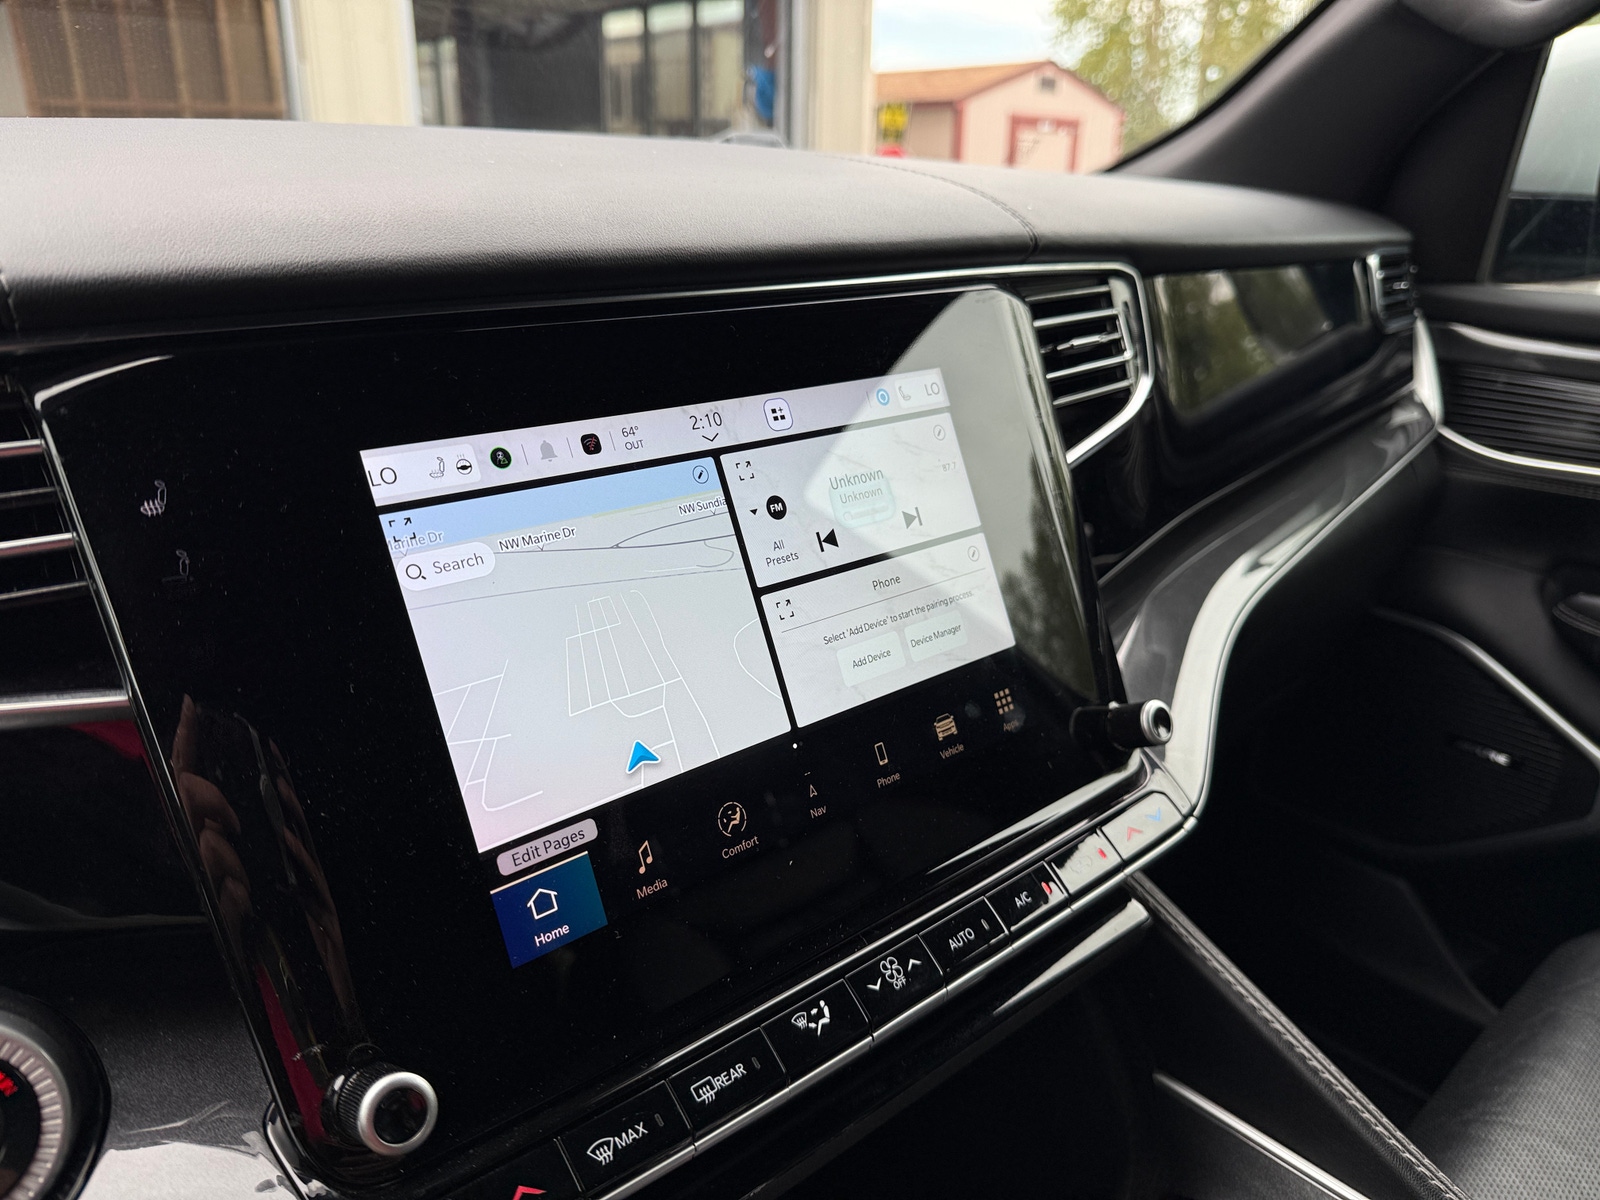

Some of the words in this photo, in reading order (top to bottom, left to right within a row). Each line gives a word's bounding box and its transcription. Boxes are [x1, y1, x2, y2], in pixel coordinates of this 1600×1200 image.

[925, 382, 939, 396] LO
[690, 411, 723, 431] 2:10
[621, 425, 639, 439] 64°
[625, 440, 644, 450] OUT
[942, 462, 957, 473] 87.7
[368, 466, 398, 487] LO
[829, 469, 884, 490] Unknown
[840, 487, 883, 504] Unknown
[679, 503, 695, 515] NW
[770, 503, 784, 514] FM
[427, 531, 443, 544] Dr
[499, 536, 520, 551] NW
[522, 531, 561, 548] Marine
[562, 526, 576, 540] Dr
[773, 540, 785, 551] All
[433, 553, 484, 575] Search
[766, 551, 799, 567] Presets
[872, 575, 901, 591] Phone
[823, 631, 847, 645] Select
[890, 615, 898, 623] to
[899, 609, 915, 620] start
[914, 604, 926, 615] the
[926, 598, 949, 613] pairing
[948, 590, 974, 605] process.
[910, 634, 933, 648] Device
[933, 624, 962, 640] Manager
[852, 656, 867, 669] Add
[867, 649, 892, 663] Device
[1003, 719, 1019, 732] Apps
[939, 743, 965, 760] Vehicle
[877, 772, 901, 788] Phone
[810, 805, 827, 819] Nav
[511, 842, 542, 867] Edit
[544, 827, 586, 858] Pages
[721, 835, 760, 860] Comfort
[636, 877, 668, 900] Media
[1014, 891, 1032, 908] A/C
[534, 922, 570, 947] Home
[948, 928, 975, 951] AUTO
[893, 975, 907, 990] OFF
[714, 1063, 747, 1091] REAR
[614, 1121, 649, 1150] MAX
